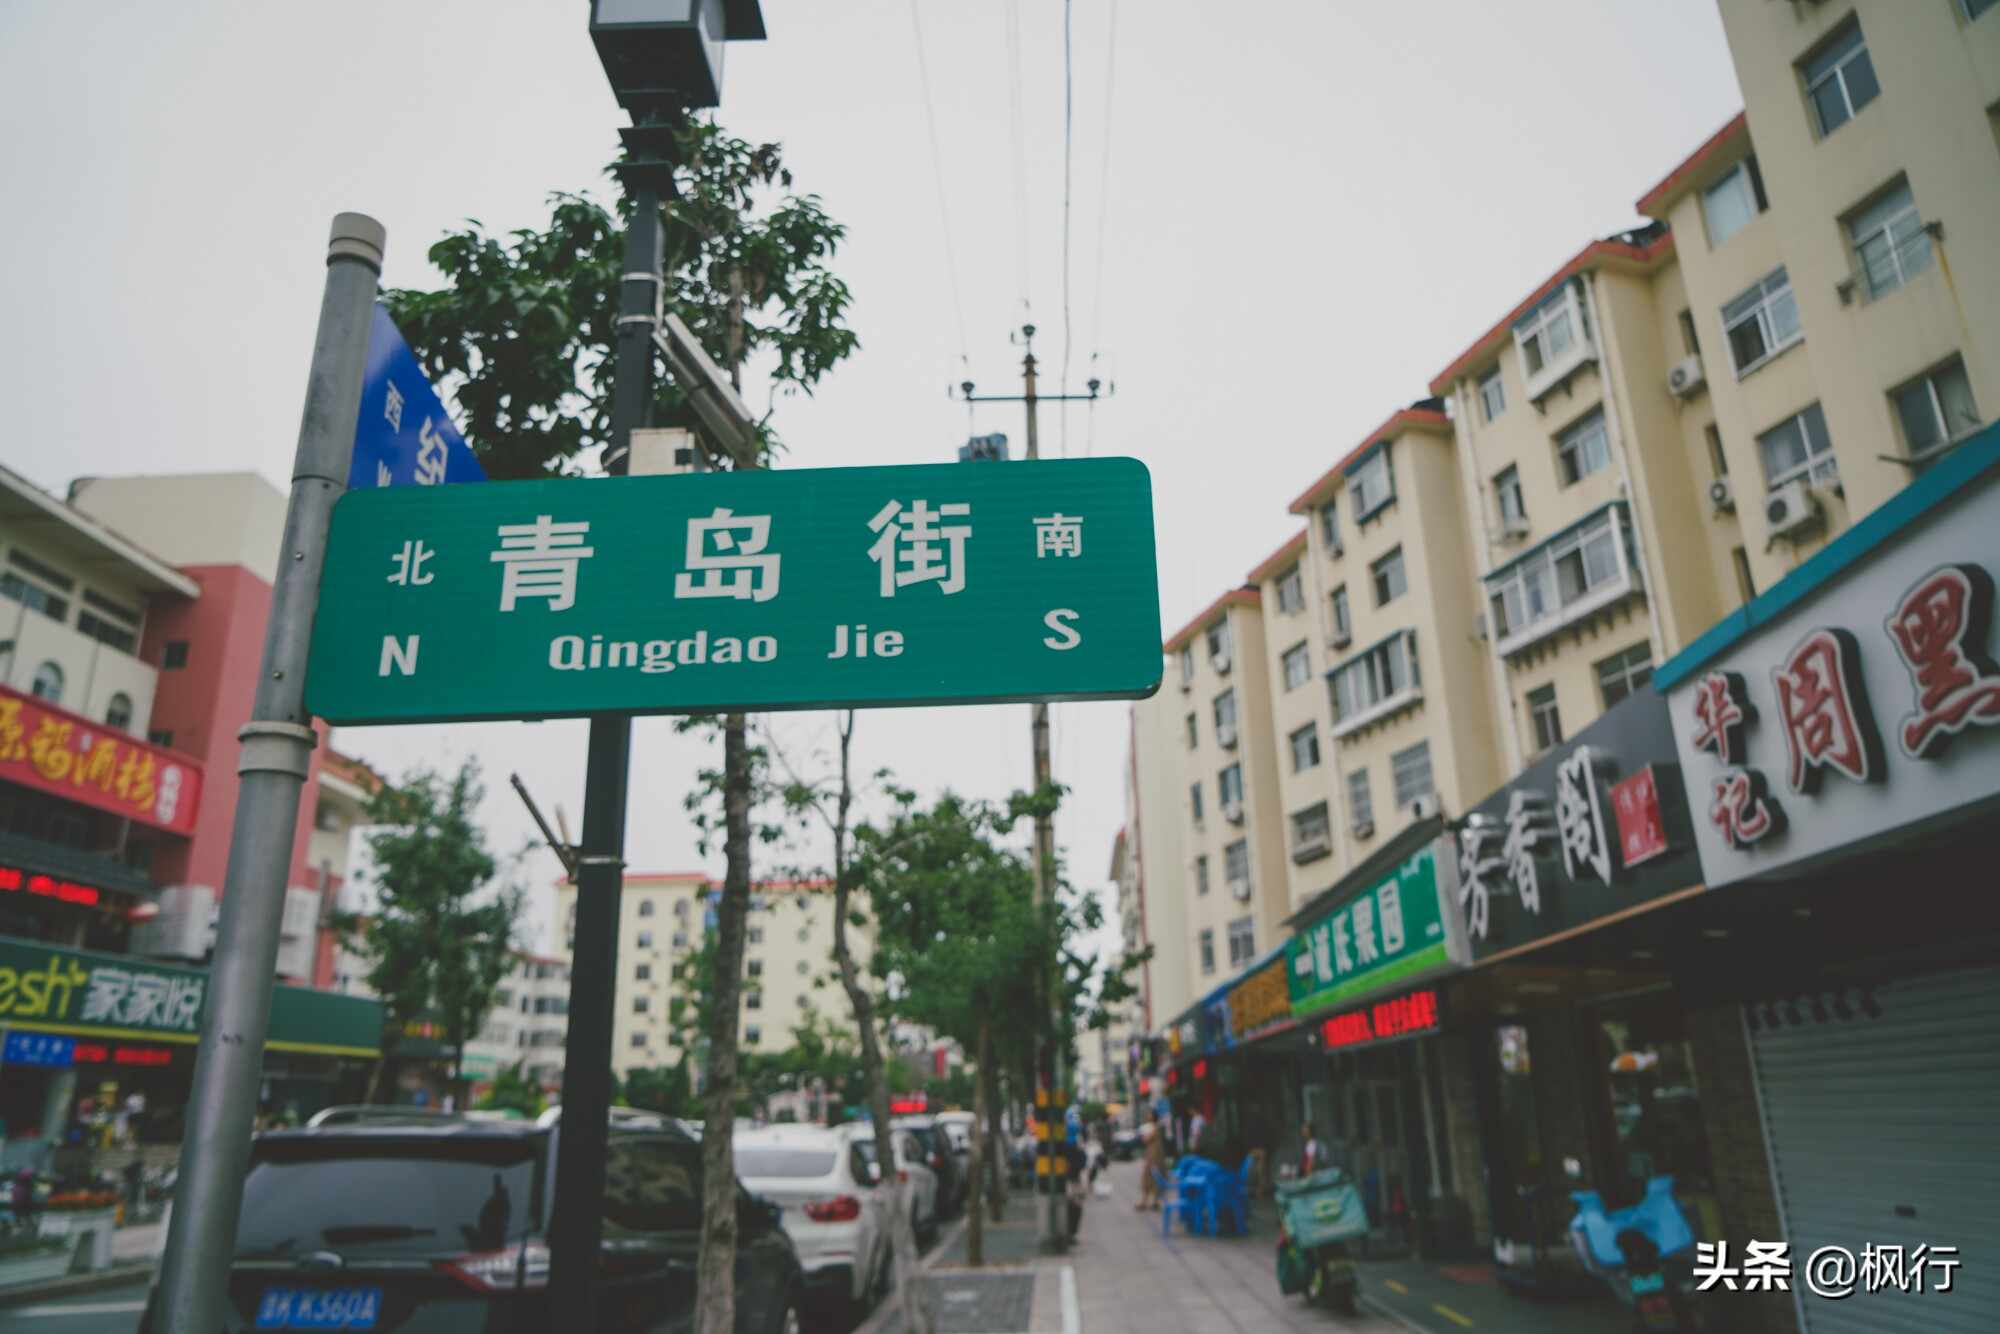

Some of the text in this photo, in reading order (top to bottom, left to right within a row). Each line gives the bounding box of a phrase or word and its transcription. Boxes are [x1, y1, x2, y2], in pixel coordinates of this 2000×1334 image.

[491, 500, 971, 611] 青岛街
[1034, 513, 1083, 557] 南
[388, 541, 433, 585] 北
[550, 625, 903, 672] Qingdao Jie
[1045, 609, 1080, 649] S
[380, 636, 419, 675] N
[82, 967, 203, 1030] 家家悦
